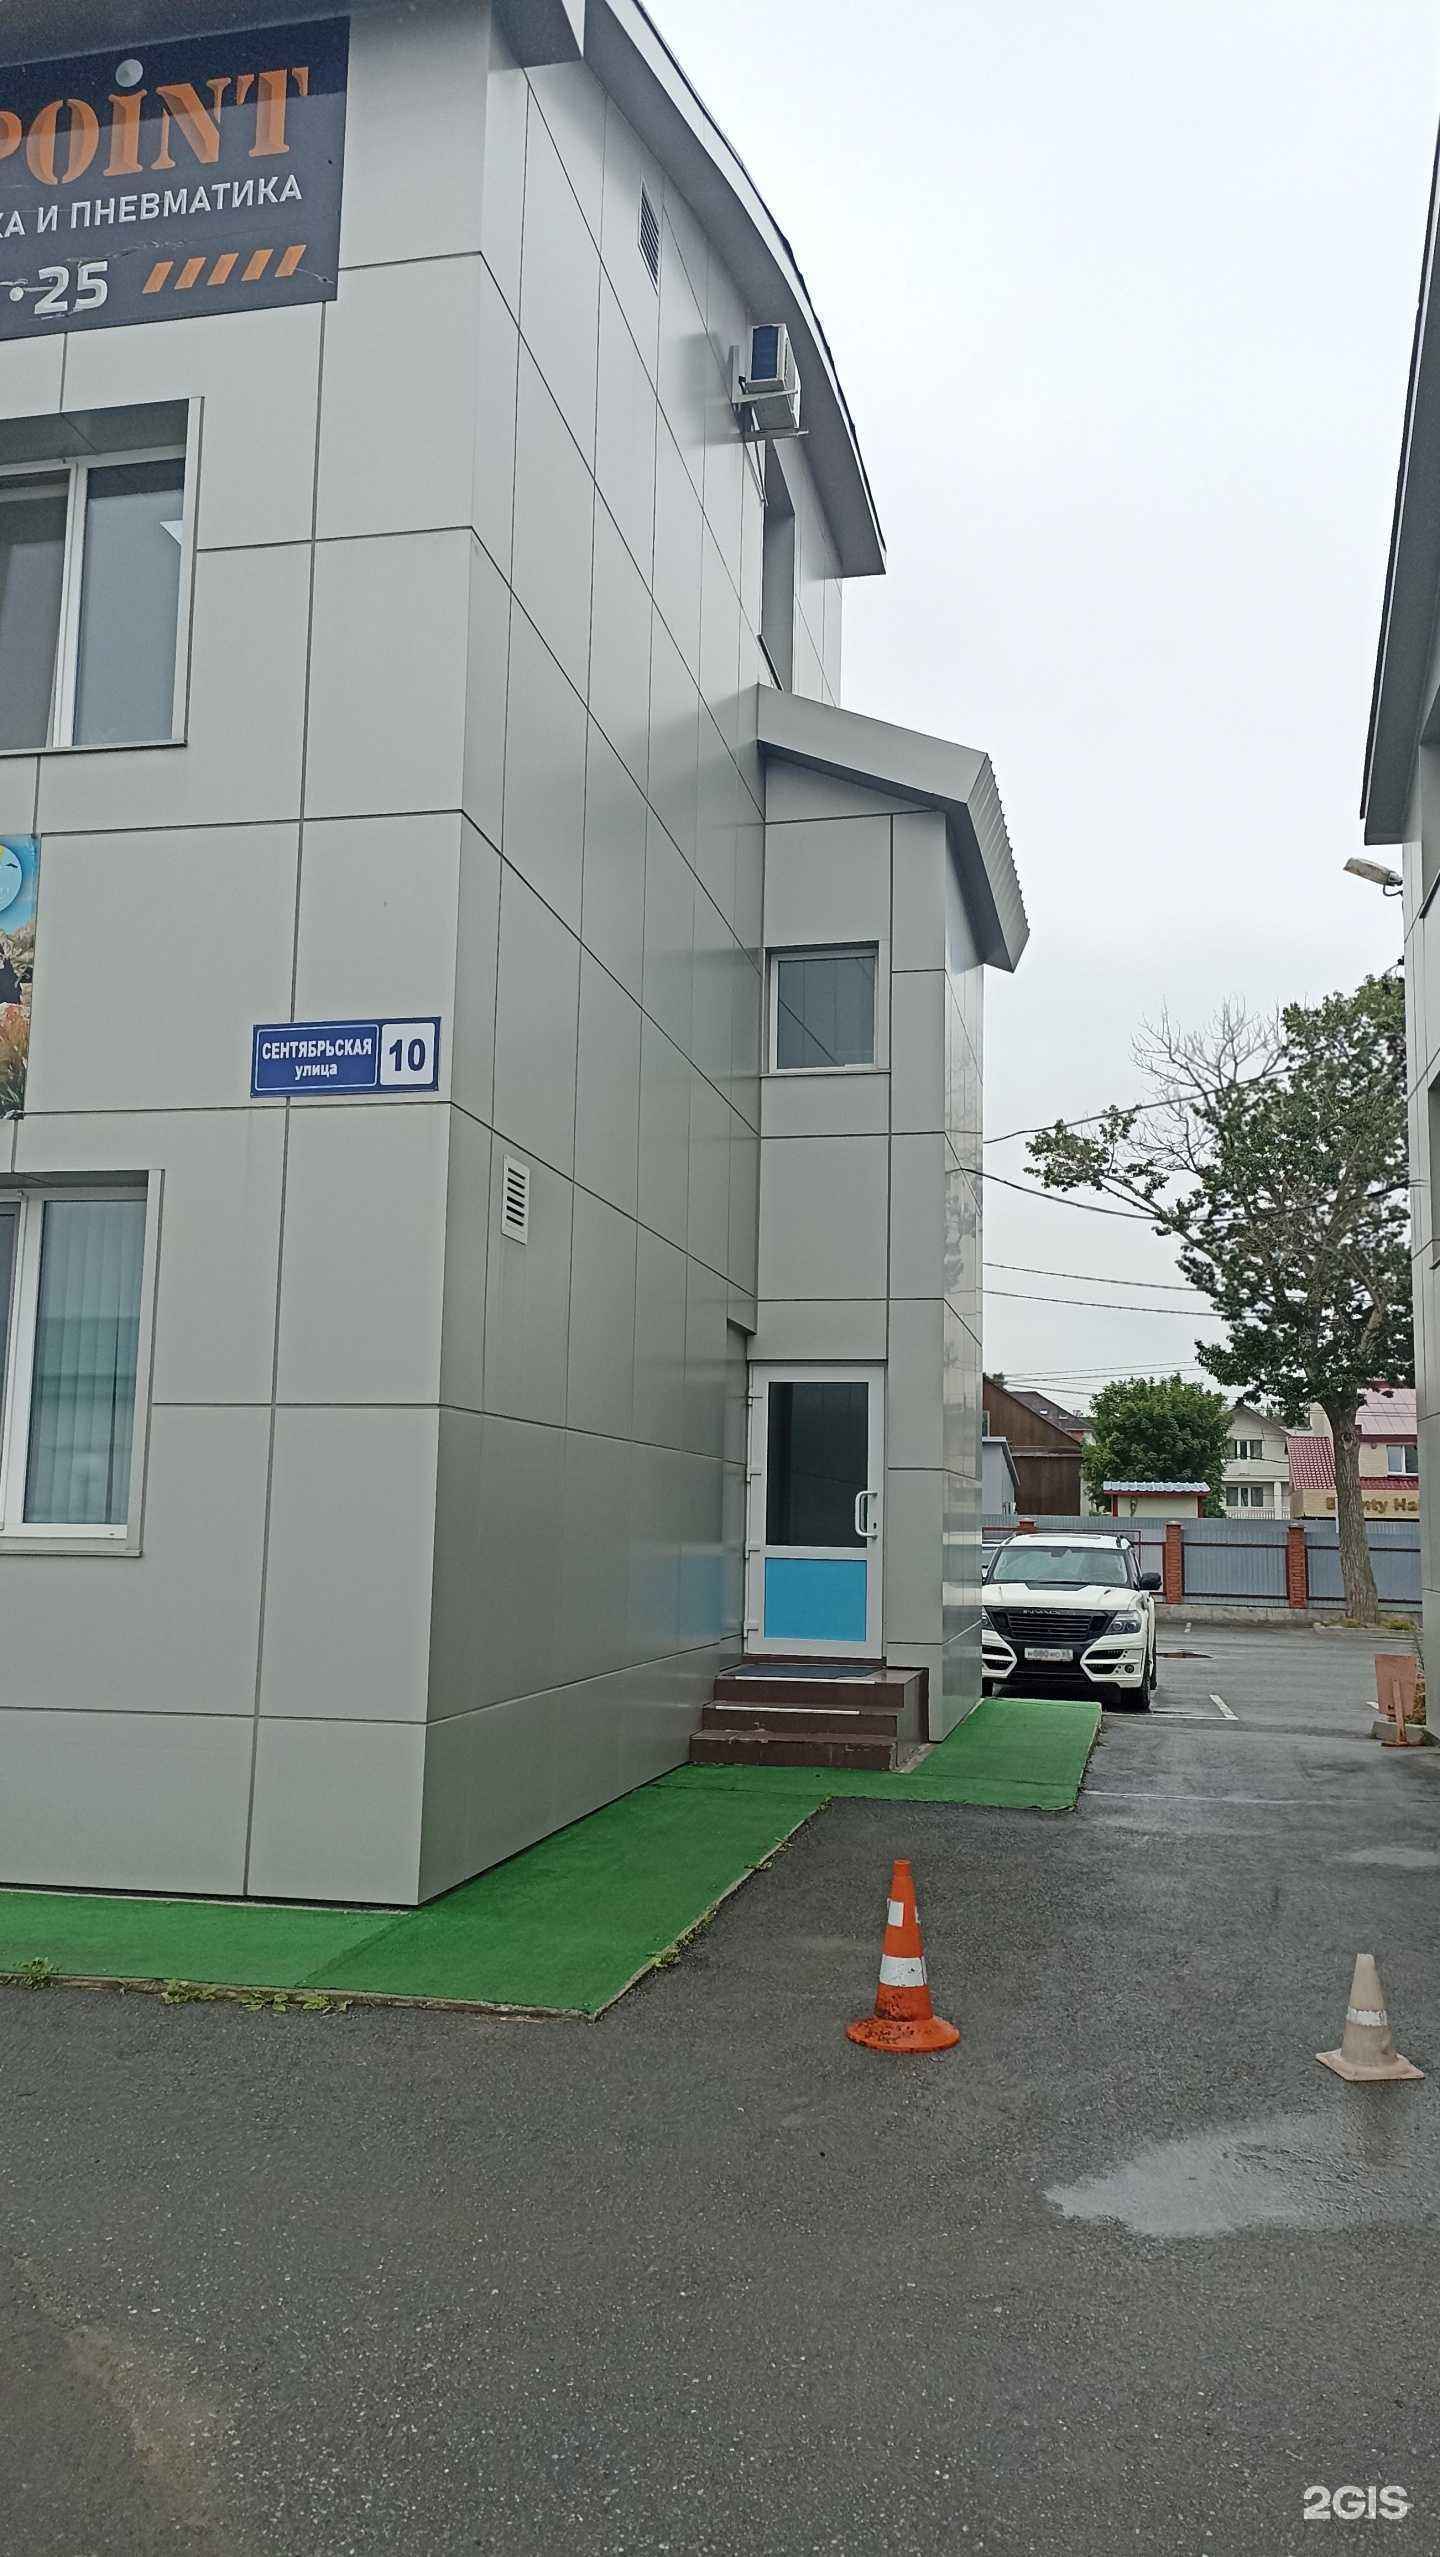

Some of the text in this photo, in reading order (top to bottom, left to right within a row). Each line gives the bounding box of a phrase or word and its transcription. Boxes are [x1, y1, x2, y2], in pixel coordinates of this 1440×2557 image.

[37, 204, 58, 233] И
[70, 174, 302, 229] ПНЕВМАТИКА
[262, 1038, 372, 1060] СЕНТЯБРЬСКАЯ
[389, 1038, 426, 1072] 10
[295, 1063, 338, 1080] улица
